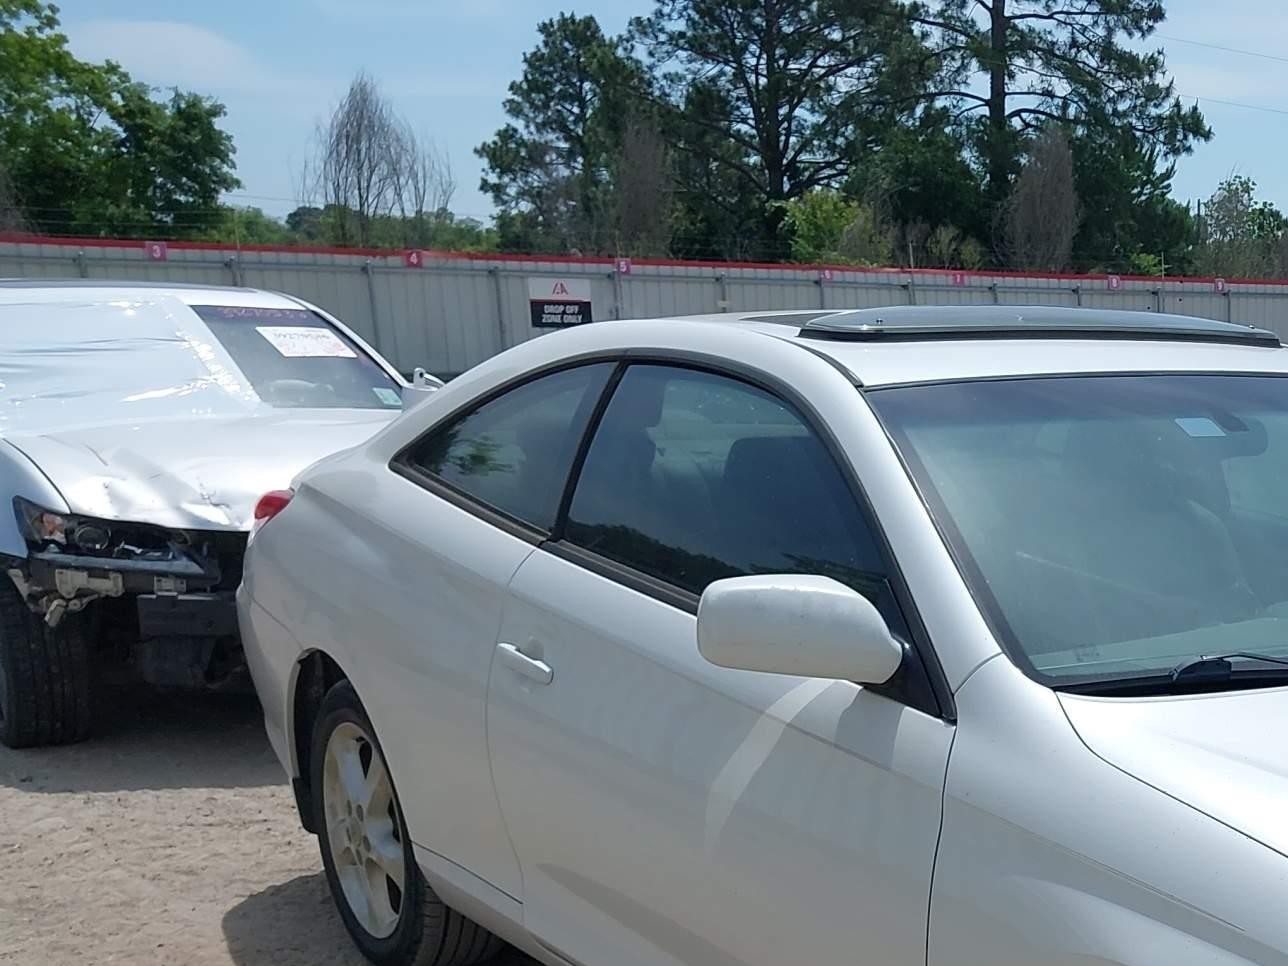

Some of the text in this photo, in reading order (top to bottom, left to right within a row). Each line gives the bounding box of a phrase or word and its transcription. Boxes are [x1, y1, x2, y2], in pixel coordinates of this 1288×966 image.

[152, 245, 161, 258] 3
[410, 252, 418, 265] 4
[620, 261, 627, 272] 5
[544, 305, 580, 314] DROP OFF
[542, 314, 583, 323] ZONE ONLY
